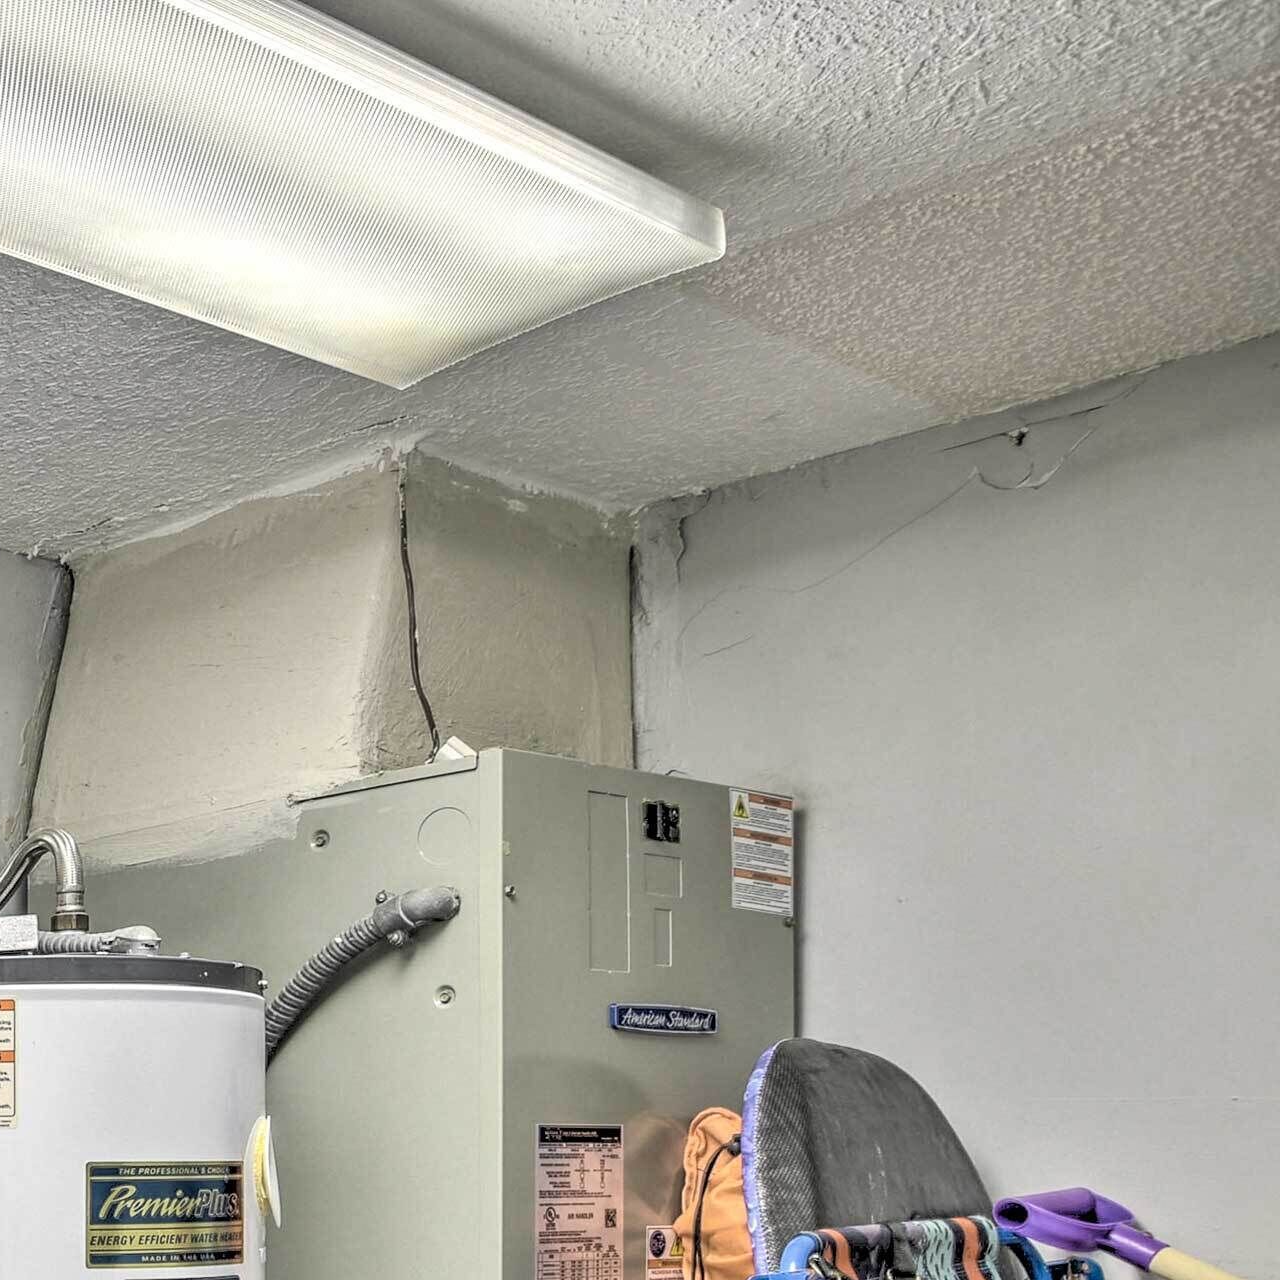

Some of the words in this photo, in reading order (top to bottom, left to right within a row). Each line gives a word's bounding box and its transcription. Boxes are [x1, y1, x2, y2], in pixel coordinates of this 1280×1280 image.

[621, 1007, 666, 1026] American
[666, 1011, 714, 1029] Standard
[118, 1167, 136, 1176] THE
[90, 1235, 136, 1247] ENERGY
[138, 1234, 190, 1245] EFFICIENT
[190, 1233, 218, 1243] WATER
